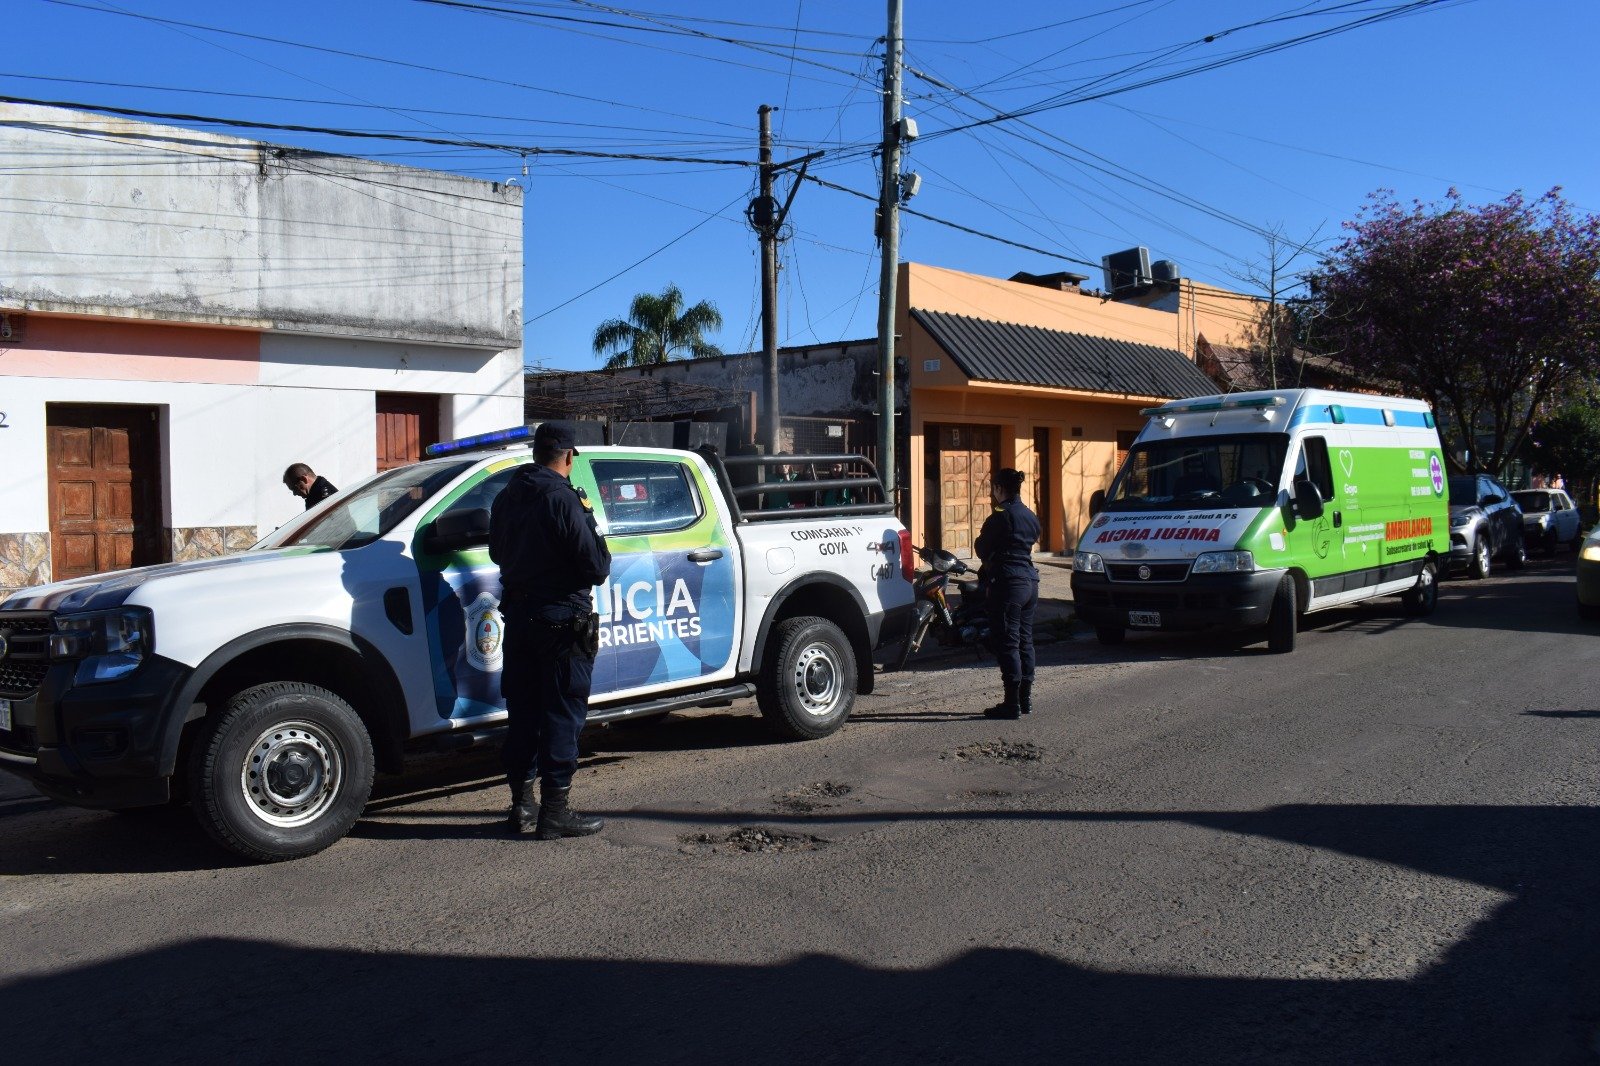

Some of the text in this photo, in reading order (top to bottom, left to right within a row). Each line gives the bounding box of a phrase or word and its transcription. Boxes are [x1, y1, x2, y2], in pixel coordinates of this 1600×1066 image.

[791, 526, 853, 541] COMISARIA
[1386, 517, 1432, 541] AMBULANCIA
[819, 541, 849, 555] GOYA
[592, 578, 697, 623] LICIA
[598, 617, 702, 648] RRIENTES
